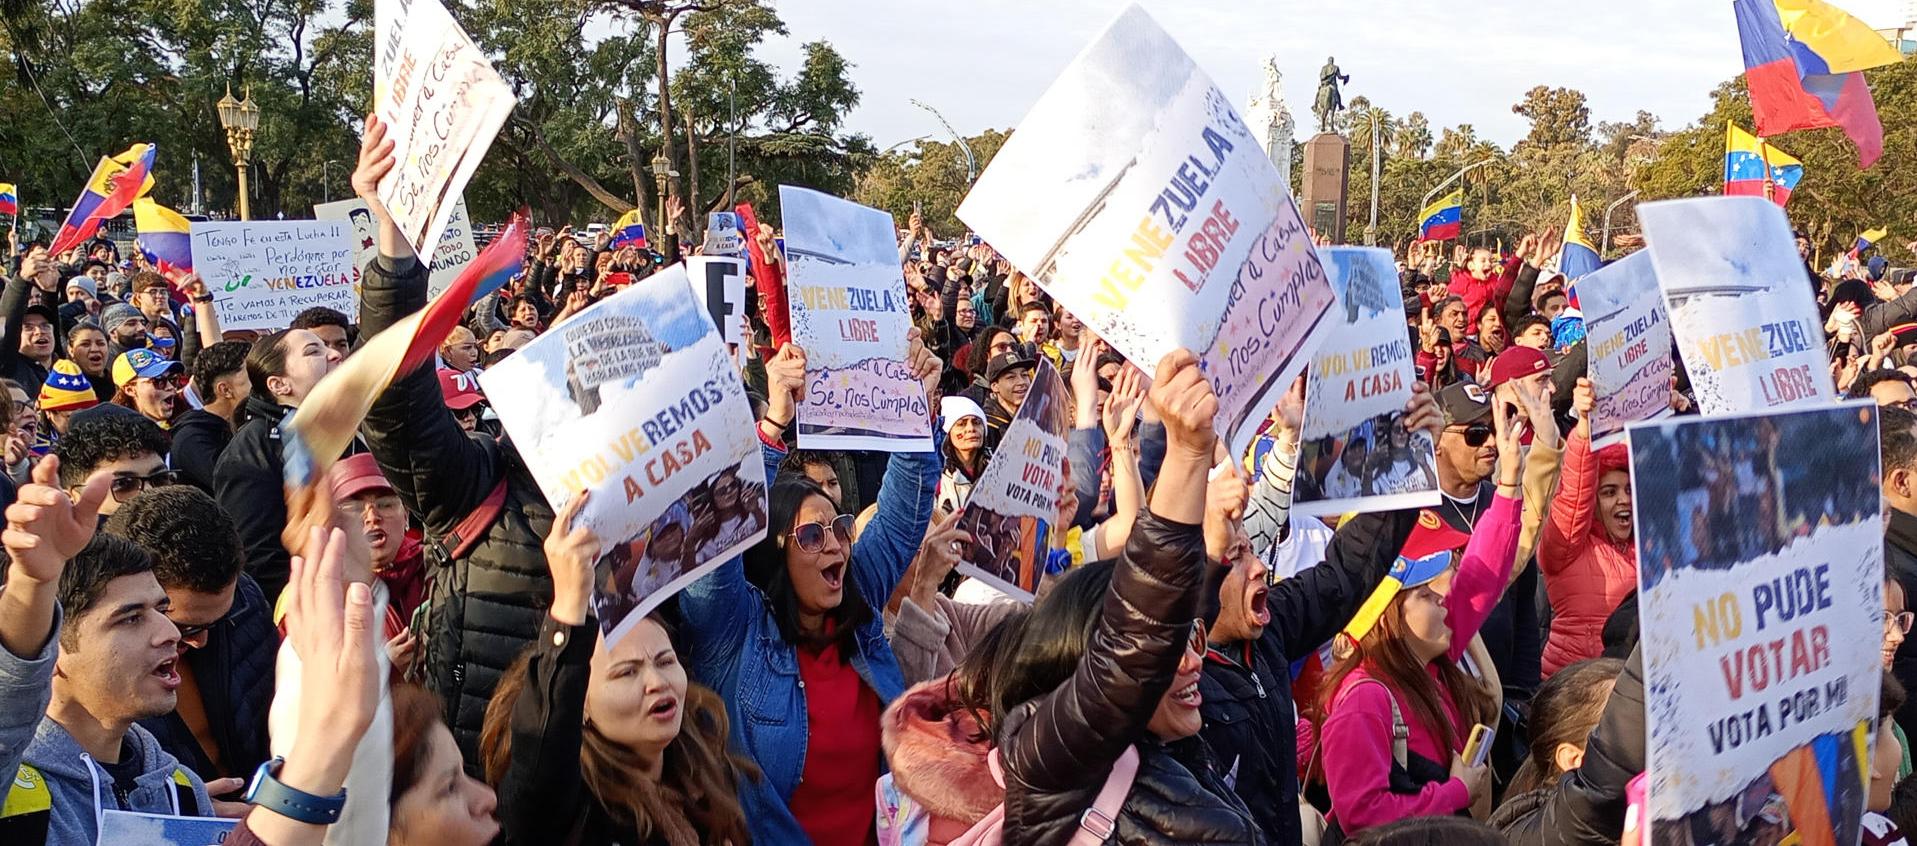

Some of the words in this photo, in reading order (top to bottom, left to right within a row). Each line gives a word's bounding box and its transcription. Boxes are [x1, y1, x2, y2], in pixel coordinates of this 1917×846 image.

[388, 48, 416, 124] LIBRE
[400, 182, 418, 216] Se
[418, 144, 439, 179] nos
[1091, 126, 1234, 310] VENEZUELA
[332, 249, 350, 262] por
[1173, 198, 1239, 295] LIBRE
[1248, 261, 1262, 281] a
[1262, 220, 1300, 263] Casa
[263, 272, 350, 292] VENEZUELA
[279, 265, 298, 275] no
[240, 299, 275, 310] VAMOS
[280, 297, 286, 306] A
[800, 285, 896, 312] VENEZUELA
[839, 318, 879, 342] LIBRE
[1594, 308, 1659, 360] VENEZUELA
[873, 361, 882, 376] a
[885, 362, 918, 381] Casa
[1227, 336, 1261, 376] nos
[1320, 339, 1407, 379] VOLVEREMOS
[1618, 338, 1648, 370] LIBRE
[811, 380, 835, 406] Se
[844, 387, 870, 408] nos
[1344, 379, 1356, 403] A
[1361, 369, 1402, 399] CASA
[1759, 364, 1817, 407] LIBRE
[560, 379, 723, 494] VOLVEREMOS
[1023, 437, 1041, 459] NO
[623, 475, 644, 505] A
[645, 428, 712, 488] CASA
[1022, 461, 1055, 492] VOTAR
[1006, 482, 1032, 504] VOTA
[1032, 493, 1047, 511] POR
[1693, 592, 1742, 650] NO
[1753, 563, 1832, 631] PUDE
[1720, 625, 1831, 700] VOTAR
[1707, 702, 1772, 755] VOTA
[1779, 686, 1820, 731] POR
